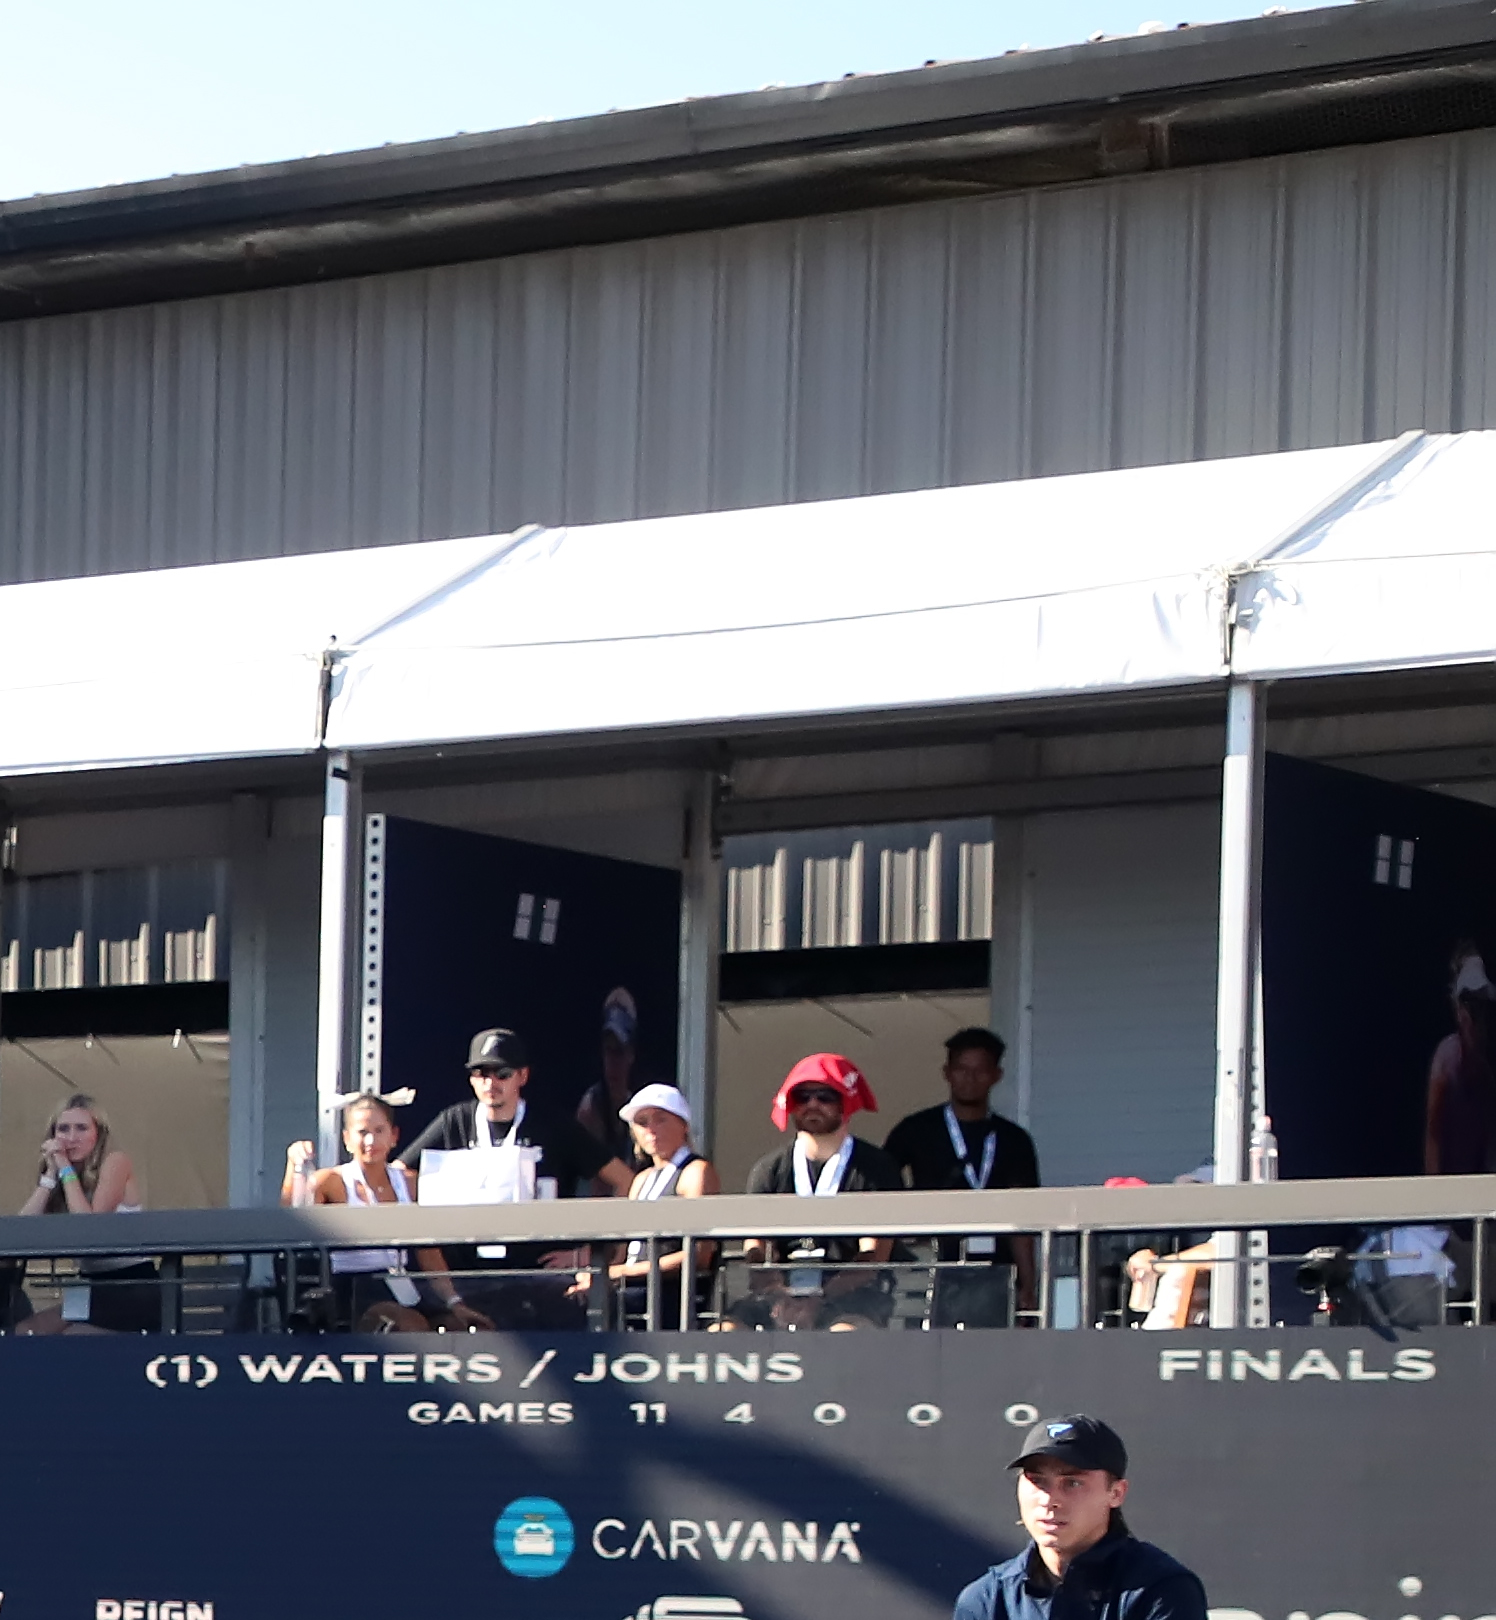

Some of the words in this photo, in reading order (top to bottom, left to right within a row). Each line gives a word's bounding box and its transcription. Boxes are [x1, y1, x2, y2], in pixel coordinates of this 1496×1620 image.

[145, 1354, 218, 1388] (1)
[238, 1354, 502, 1384] WATERS
[519, 1349, 557, 1388] /
[574, 1352, 803, 1385] JOHNS
[1159, 1348, 1437, 1382] FINALS
[408, 1402, 574, 1424] GAMES
[630, 1403, 667, 1423] 11
[723, 1403, 755, 1423] 4
[813, 1402, 846, 1424] 0
[907, 1402, 941, 1425] 0
[1004, 1402, 1039, 1427] 0
[592, 1518, 861, 1563] CARVANA
